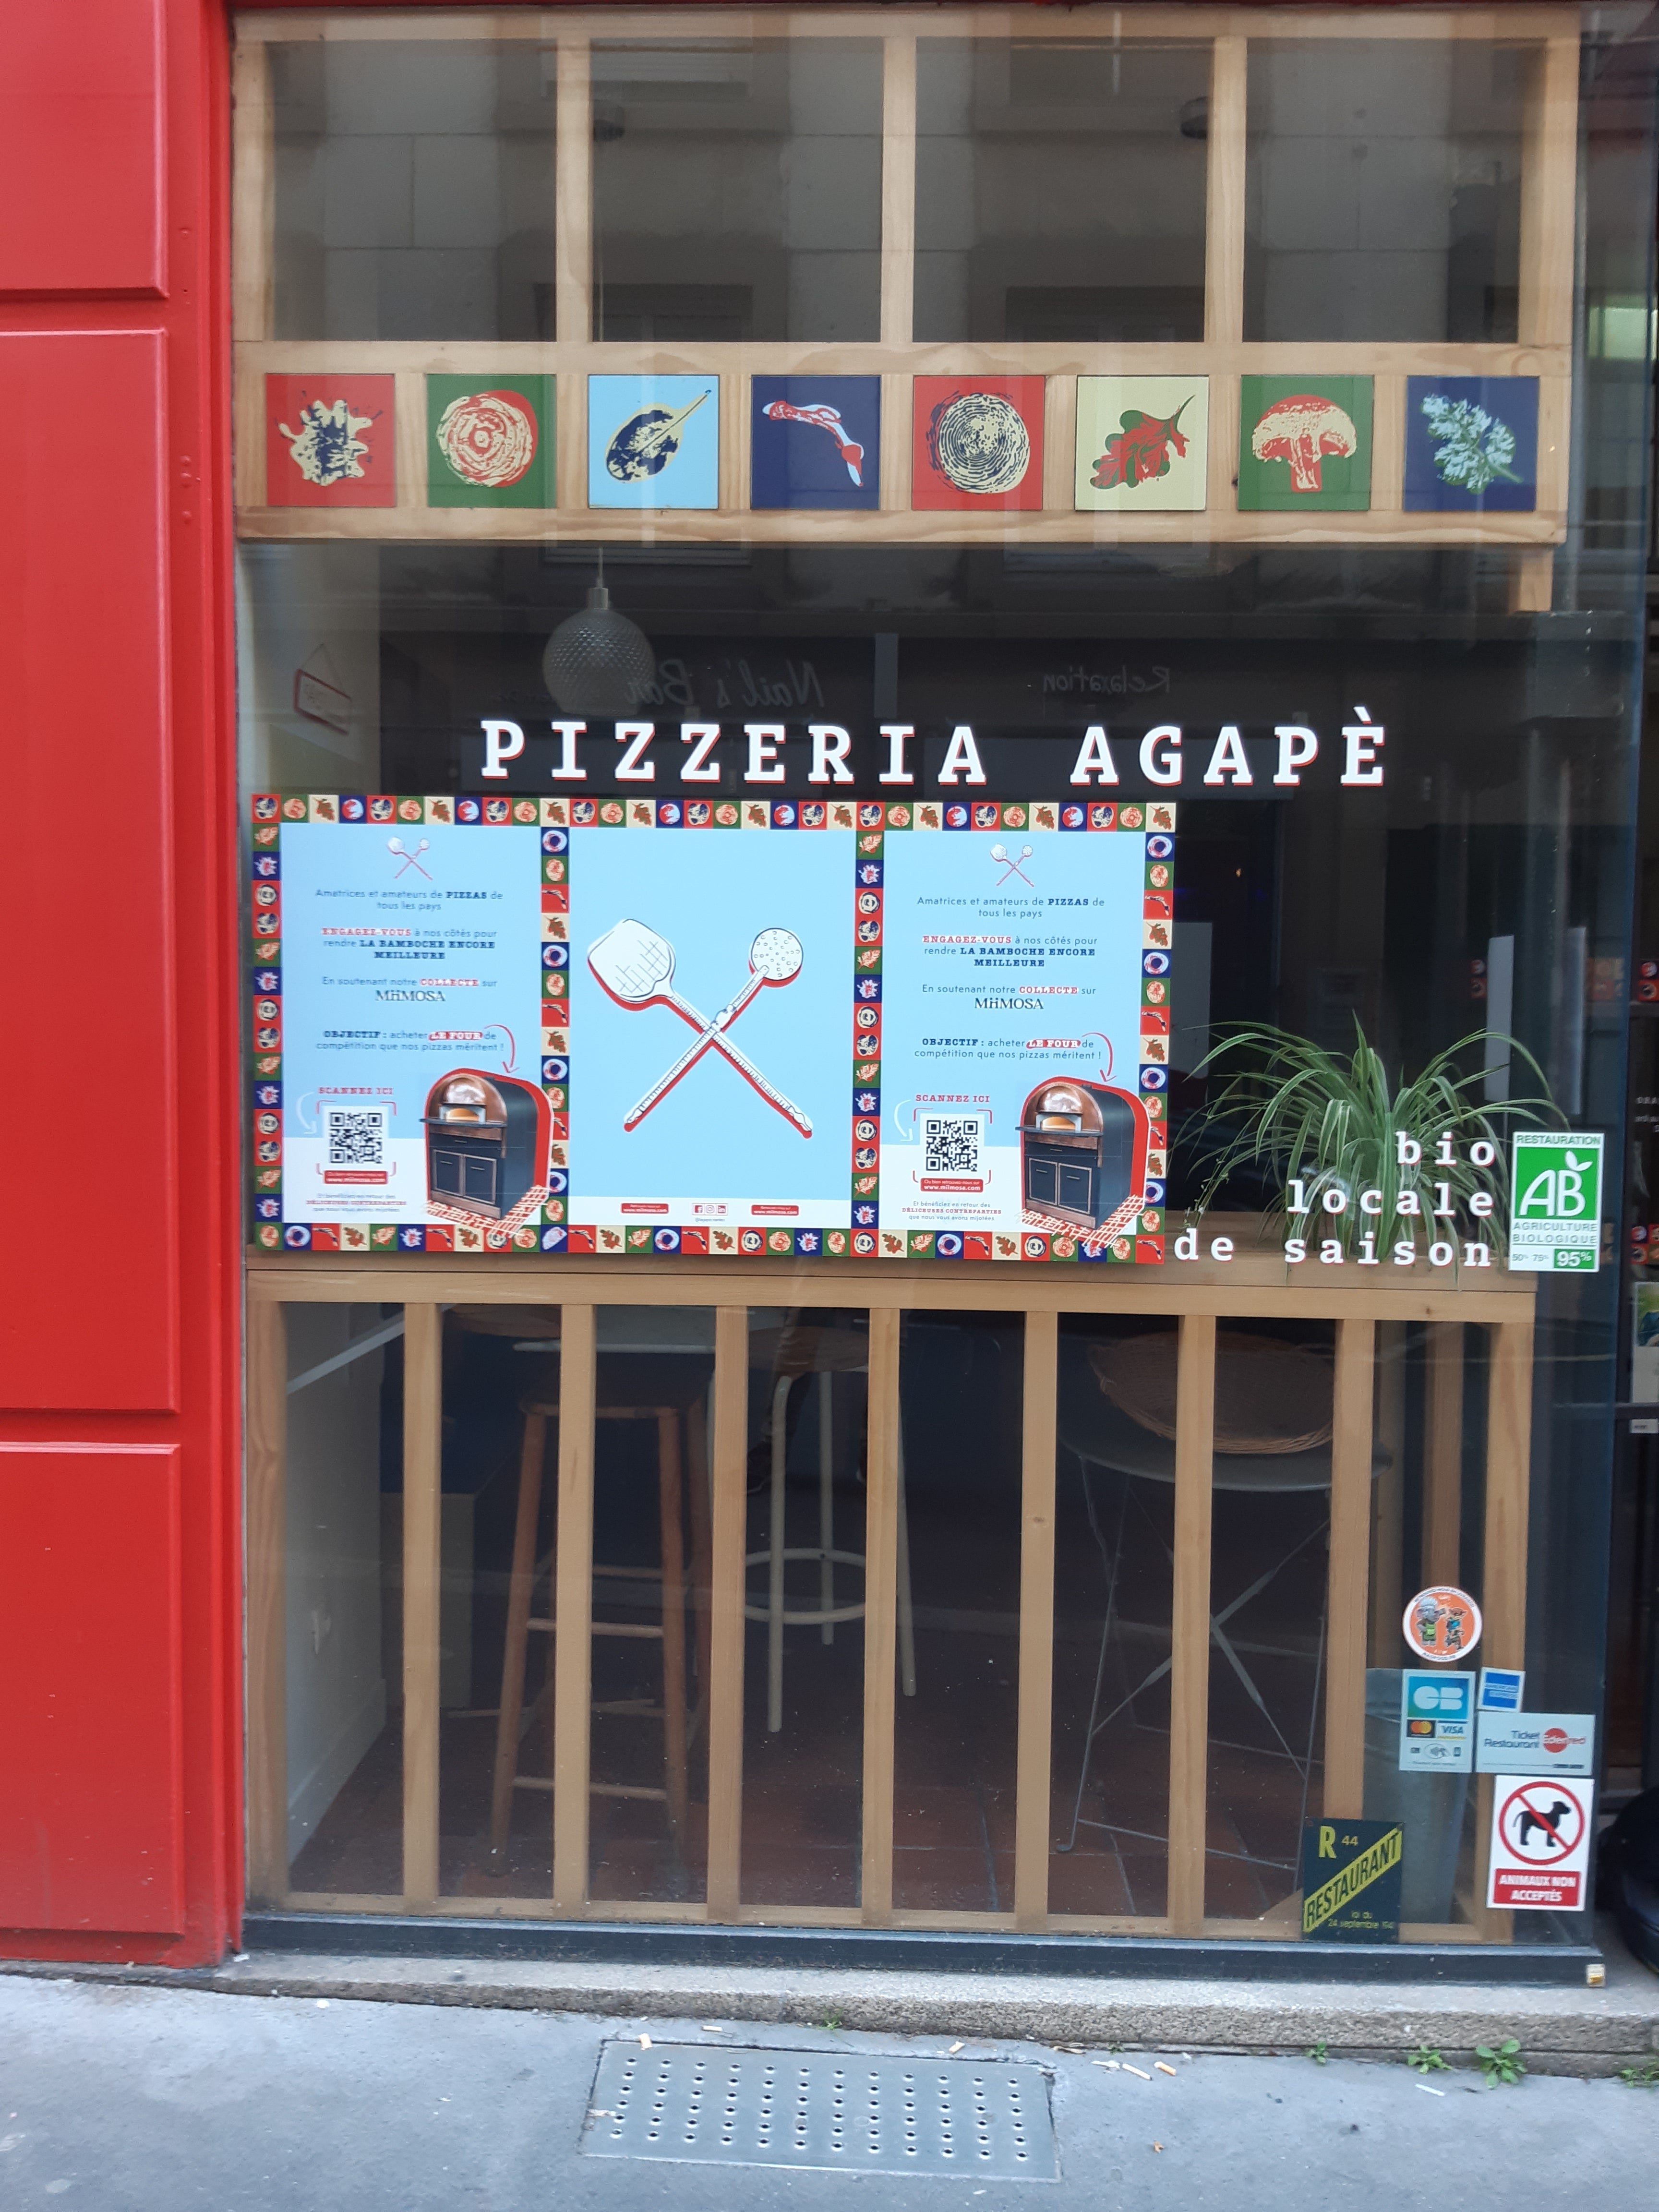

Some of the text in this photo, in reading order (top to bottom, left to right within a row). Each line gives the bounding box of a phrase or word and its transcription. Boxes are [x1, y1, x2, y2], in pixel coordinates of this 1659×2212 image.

[481, 706, 1385, 786] PIZZERIA AGAPÈ
[917, 897, 967, 905] Amatrices
[1032, 897, 1044, 906] de
[1092, 897, 1105, 906] de
[1003, 908, 1016, 917] les
[1020, 911, 1042, 919] pays
[923, 936, 1011, 944] ENGAGEZ-VOUS
[1045, 936, 1071, 945] côtés
[1074, 938, 1097, 947] pour
[924, 946, 957, 955] rendre
[922, 984, 934, 992] En
[1019, 986, 1079, 994] COLLECTE
[974, 997, 1044, 1010] MiiMOSA
[987, 1038, 1025, 1047] acheter
[1046, 1040, 1080, 1048] FOUR
[1082, 1039, 1094, 1048] de
[914, 1049, 974, 1059] compétition
[977, 1052, 995, 1060] que
[1019, 1050, 1049, 1060] pizzas
[1053, 1050, 1095, 1059] méritent
[915, 1094, 969, 1103] SCANNEZ
[1516, 1135, 1601, 1145] RESTAURATION
[1395, 1130, 1495, 1167] bio
[1286, 1179, 1493, 1217] locale
[1519, 1169, 1586, 1217] AB
[1513, 1222, 1598, 1232] AGRICULTURE
[1513, 1234, 1598, 1244] BIOLOGIQUE
[1174, 1228, 1492, 1268] de saison
[1556, 1251, 1592, 1267] 95%
[1441, 1726, 1464, 1734] VISA
[1511, 1730, 1540, 1740] Ticket
[1484, 1738, 1540, 1748] Restaurant
[1318, 1825, 1358, 1859] R 44
[1307, 1832, 1399, 1929] RESTAURANT
[1499, 1874, 1576, 1887] ANIMAUX NON
[1510, 1888, 1563, 1902] ACCEPTÉS
